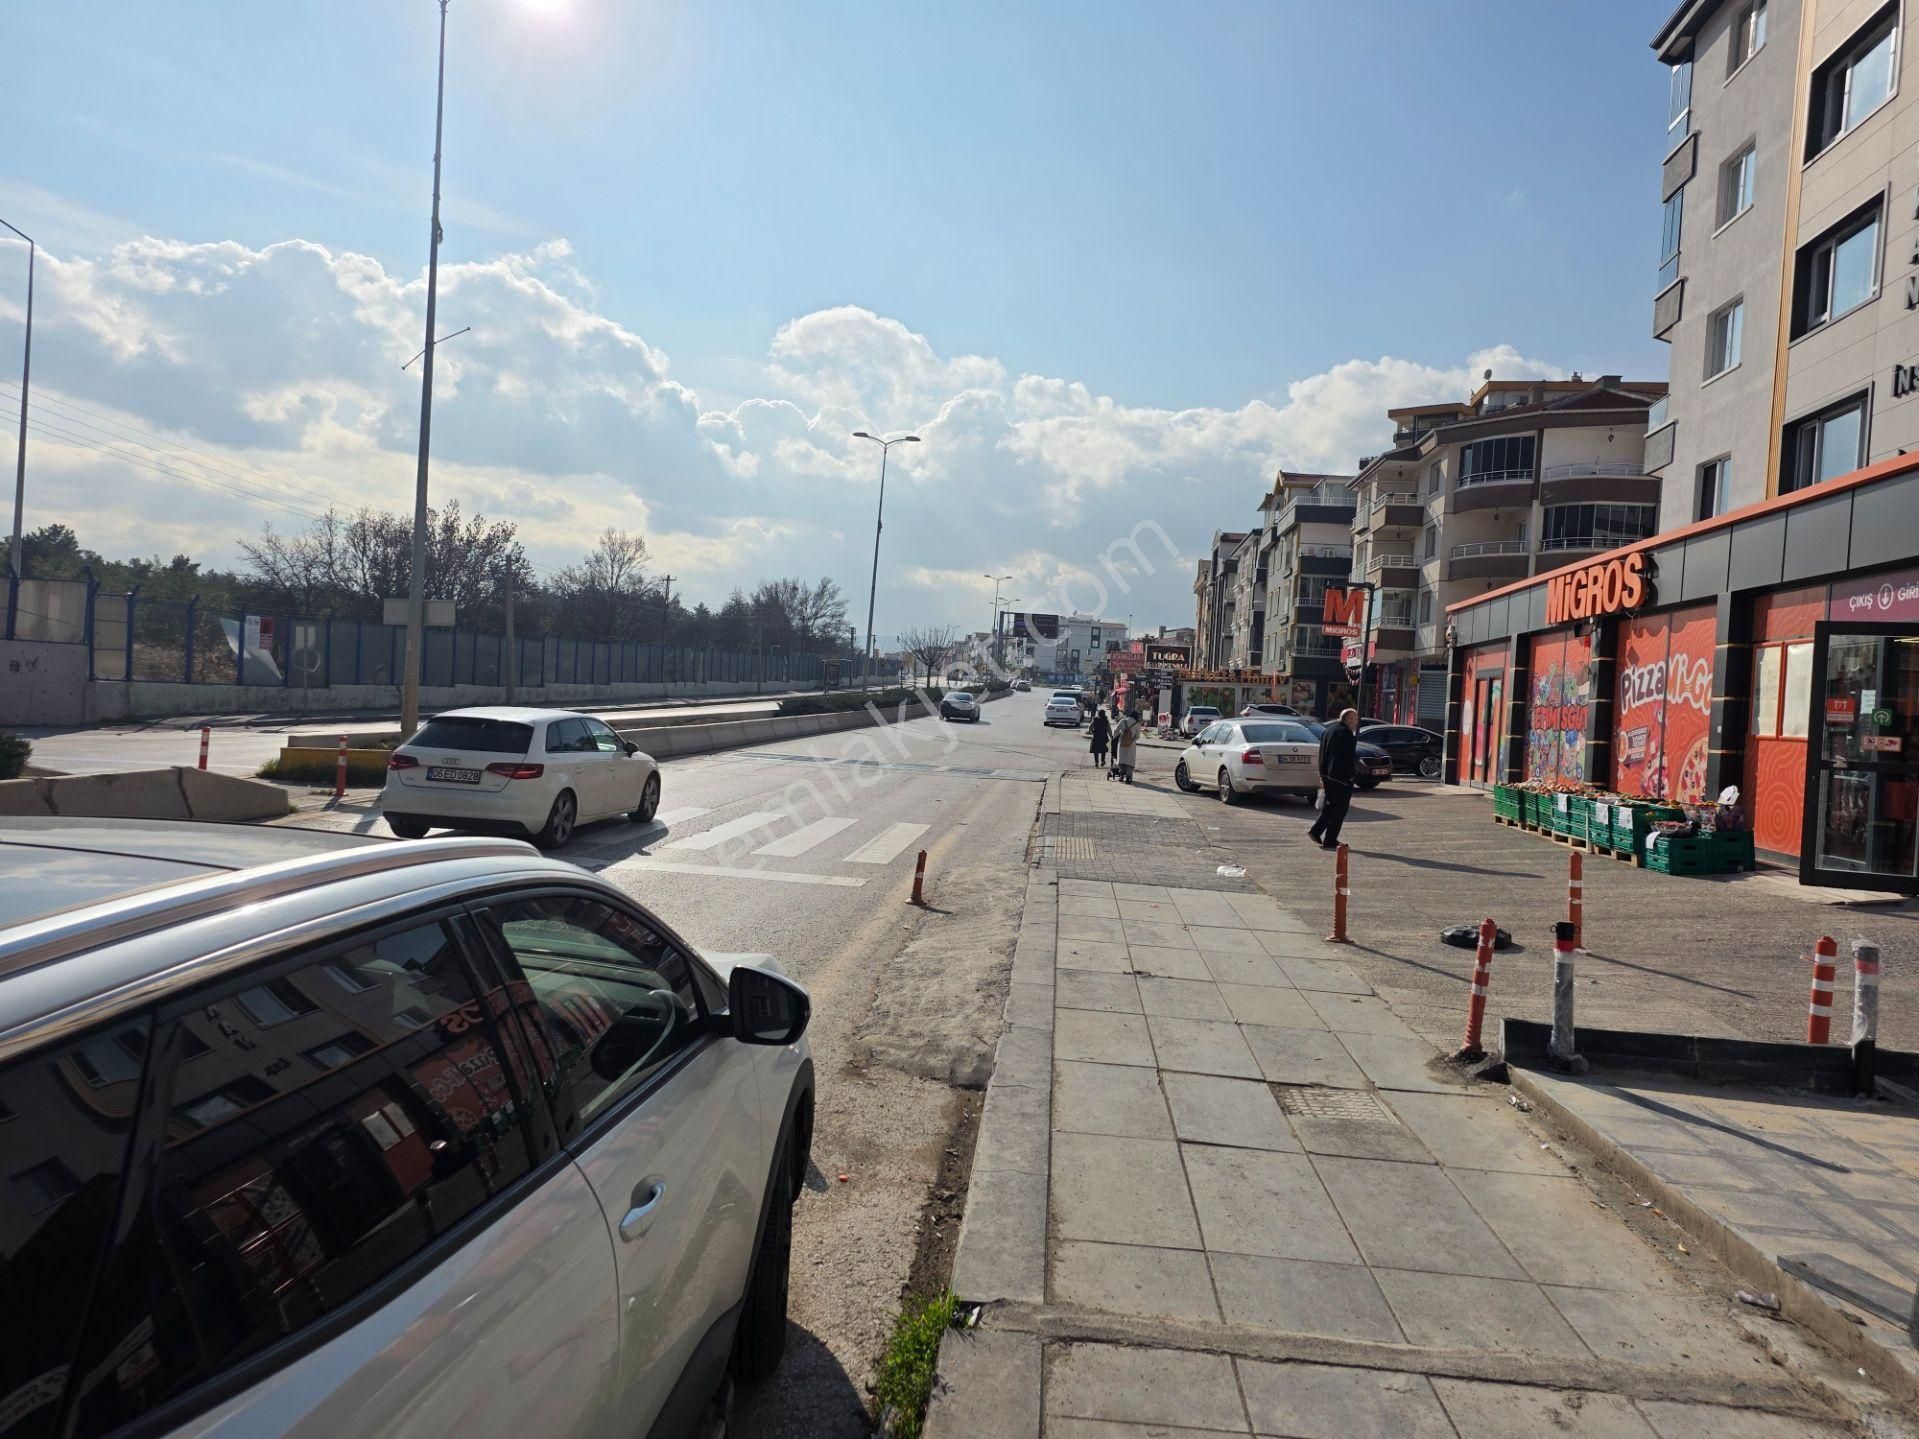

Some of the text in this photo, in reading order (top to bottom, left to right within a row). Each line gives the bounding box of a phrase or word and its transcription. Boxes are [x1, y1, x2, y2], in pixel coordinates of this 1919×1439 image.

[1323, 589, 1365, 624] M
[1849, 593, 1873, 612] ÇIKIŞ
[1620, 661, 1666, 715] Pizza
